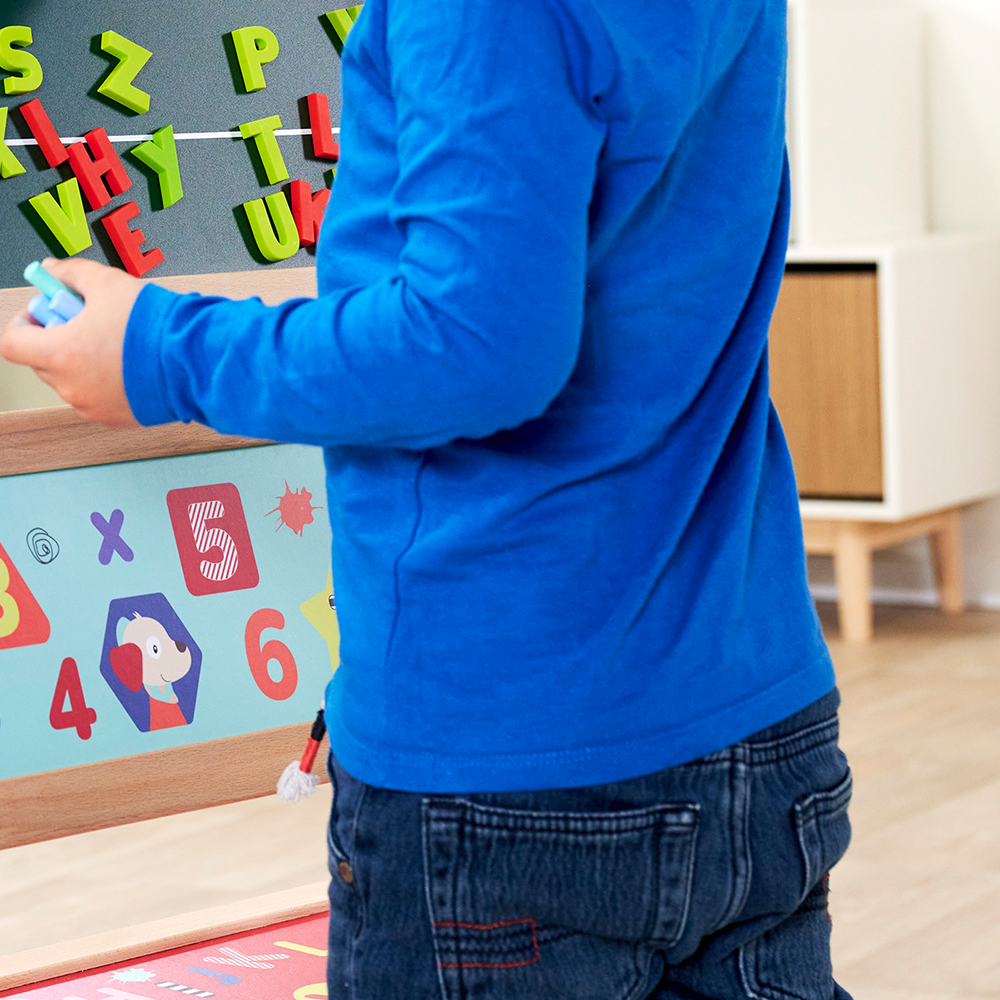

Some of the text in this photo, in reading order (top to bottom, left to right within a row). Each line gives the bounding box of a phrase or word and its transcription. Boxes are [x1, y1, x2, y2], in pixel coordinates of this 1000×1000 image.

[230, 25, 280, 93] P
[238, 114, 290, 186] T
[28, 176, 93, 257] V
[100, 200, 165, 278] E
[243, 190, 301, 262] U
[187, 499, 239, 582] 5
[244, 607, 298, 702] 6
[48, 657, 97, 741] 4
